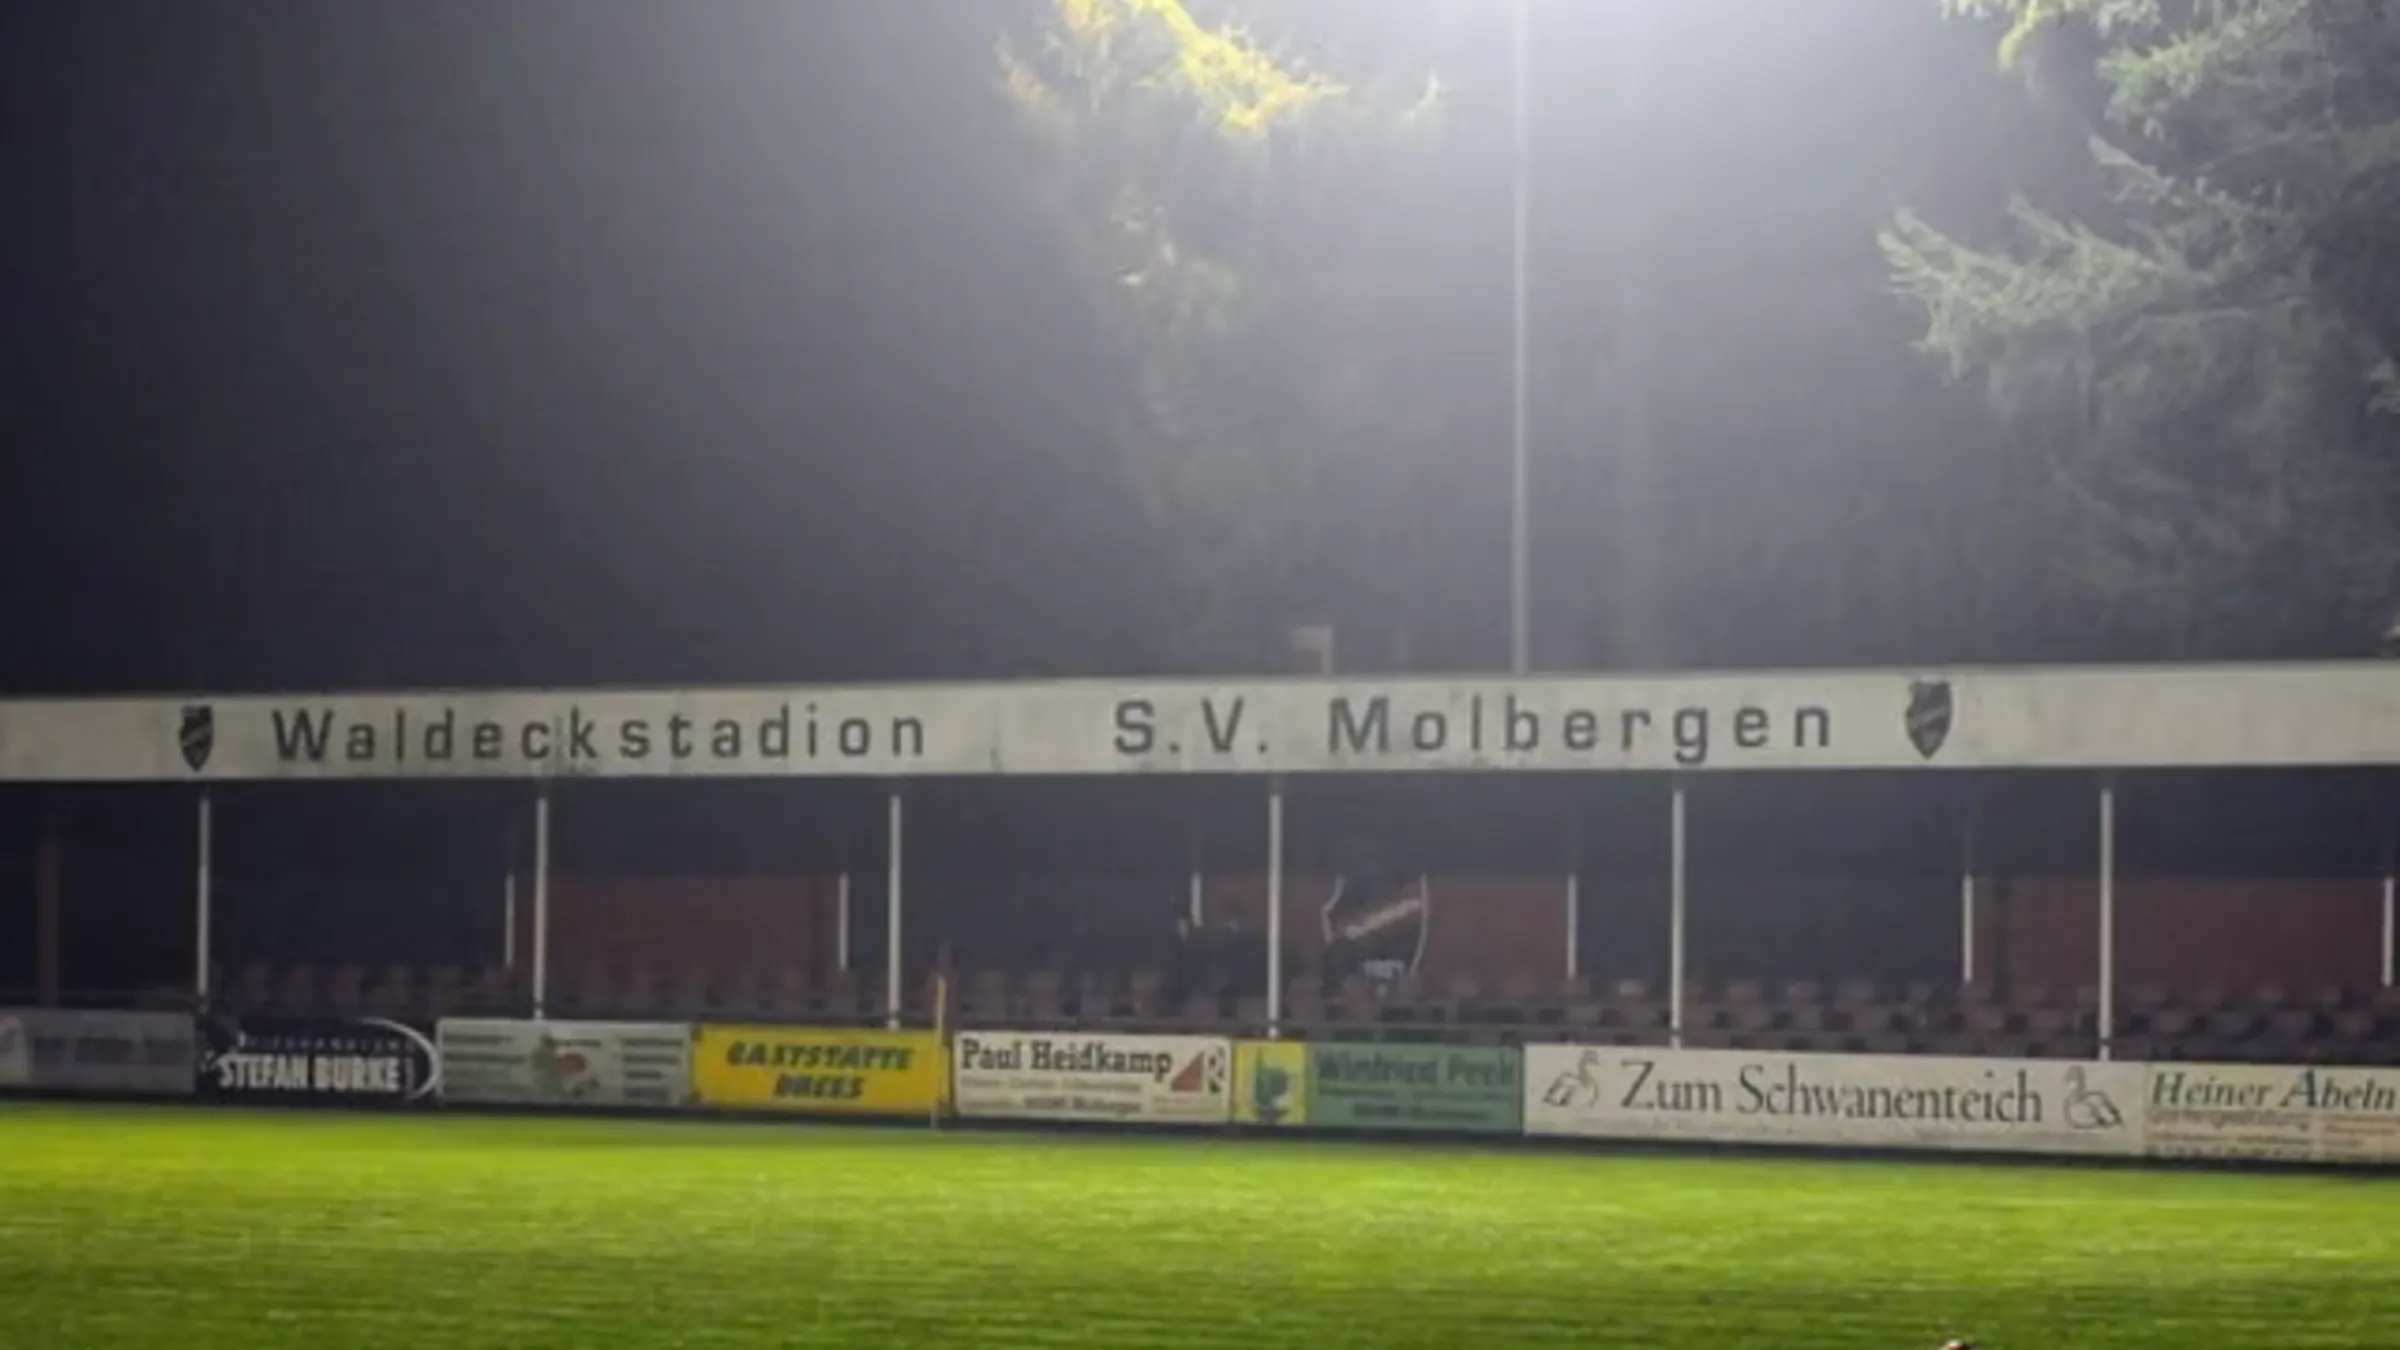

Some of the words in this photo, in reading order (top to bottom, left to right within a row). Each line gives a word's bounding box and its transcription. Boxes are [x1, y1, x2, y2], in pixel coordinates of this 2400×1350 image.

[271, 704, 926, 763] Waldeckstadion
[1113, 698, 1269, 756] S.V.
[1328, 695, 1832, 764] Molbergen
[217, 1053, 309, 1091] STEFAN
[313, 1056, 400, 1093] BURKE
[961, 1038, 1022, 1070] Paul
[1029, 1039, 1173, 1083] Heidkamp
[1620, 1060, 1723, 1112] Zum
[1735, 1062, 2042, 1124] Schwanenteich
[2151, 1071, 2273, 1107] Heiner
[2278, 1067, 2397, 1111] Abeln
